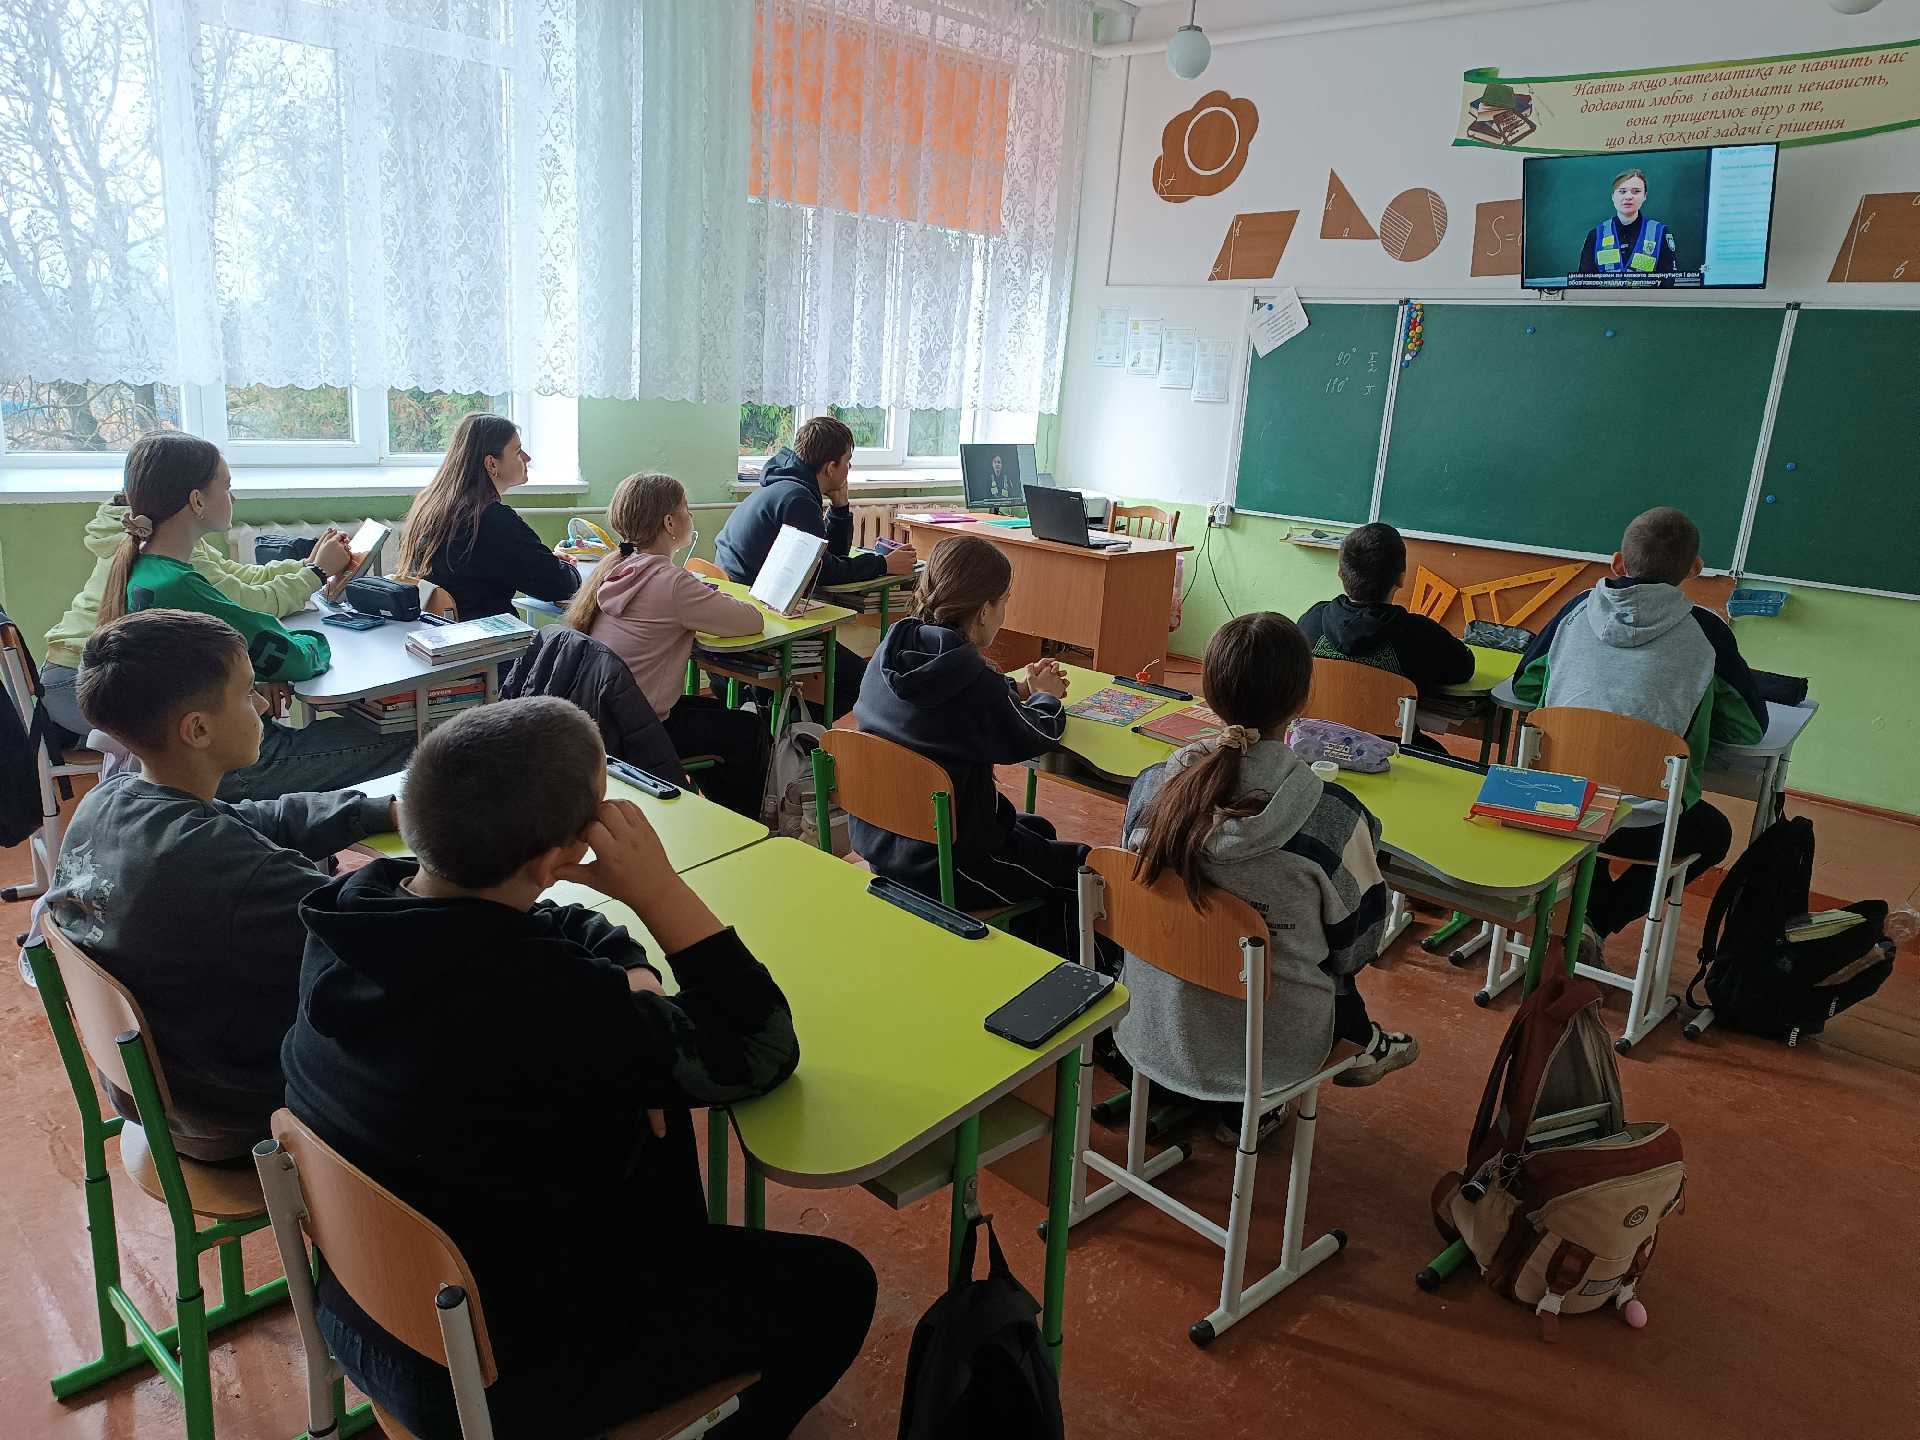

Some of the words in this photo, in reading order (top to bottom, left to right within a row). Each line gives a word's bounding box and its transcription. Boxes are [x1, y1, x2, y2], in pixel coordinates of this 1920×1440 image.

[1572, 81, 1624, 97] Навіть
[1628, 77, 1666, 93] якщо
[1669, 67, 1774, 87] математика
[1778, 63, 1796, 75] не
[1800, 56, 1873, 73] навчить
[1878, 51, 1908, 65] нас
[1580, 98, 1645, 113] додавати
[1649, 89, 1693, 107] любов
[1702, 88, 1709, 101] і
[1711, 83, 1792, 101] віднімати
[1798, 74, 1889, 93] ненависть,
[1626, 115, 1657, 127] вона
[1662, 106, 1749, 128] прищеплює
[1751, 101, 1784, 121] віру
[1787, 103, 1795, 113] в
[1800, 100, 1825, 113] те,
[1605, 135, 1624, 149] що
[1628, 131, 1653, 145] для
[1657, 126, 1713, 146] кожної
[1713, 121, 1761, 138] задачі
[1765, 124, 1775, 135] є
[1776, 118, 1846, 138] рішення
